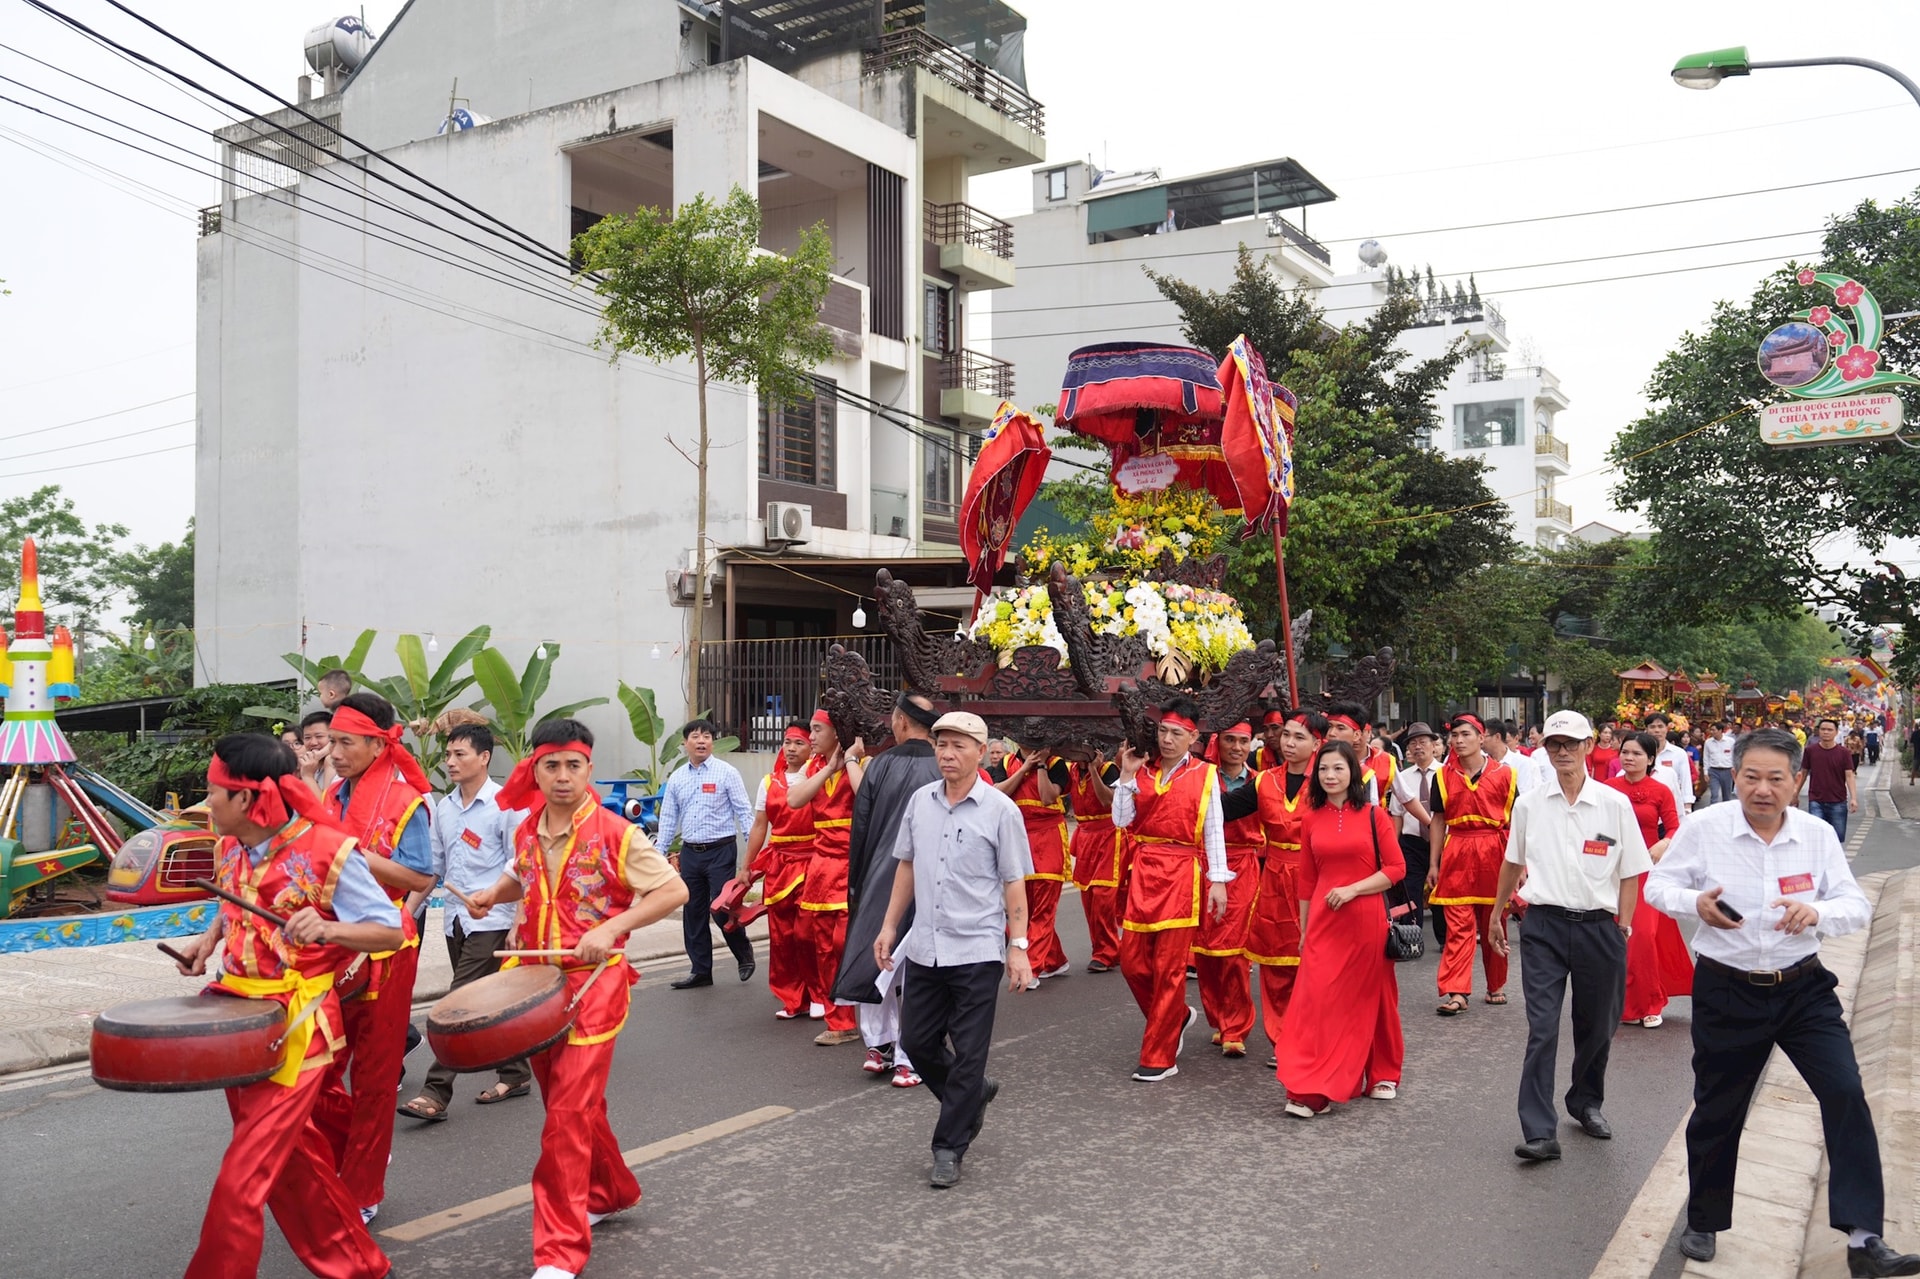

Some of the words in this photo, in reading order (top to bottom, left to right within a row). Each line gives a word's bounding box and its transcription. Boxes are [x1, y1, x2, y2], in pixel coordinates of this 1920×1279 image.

[1781, 405, 1801, 414] TÍCH
[1804, 402, 1829, 411] QUỐC
[1831, 400, 1847, 408] GIA
[1870, 396, 1893, 405] BIỆT
[1811, 410, 1832, 421] TÂY
[1834, 406, 1881, 419] PHƯƠNG
